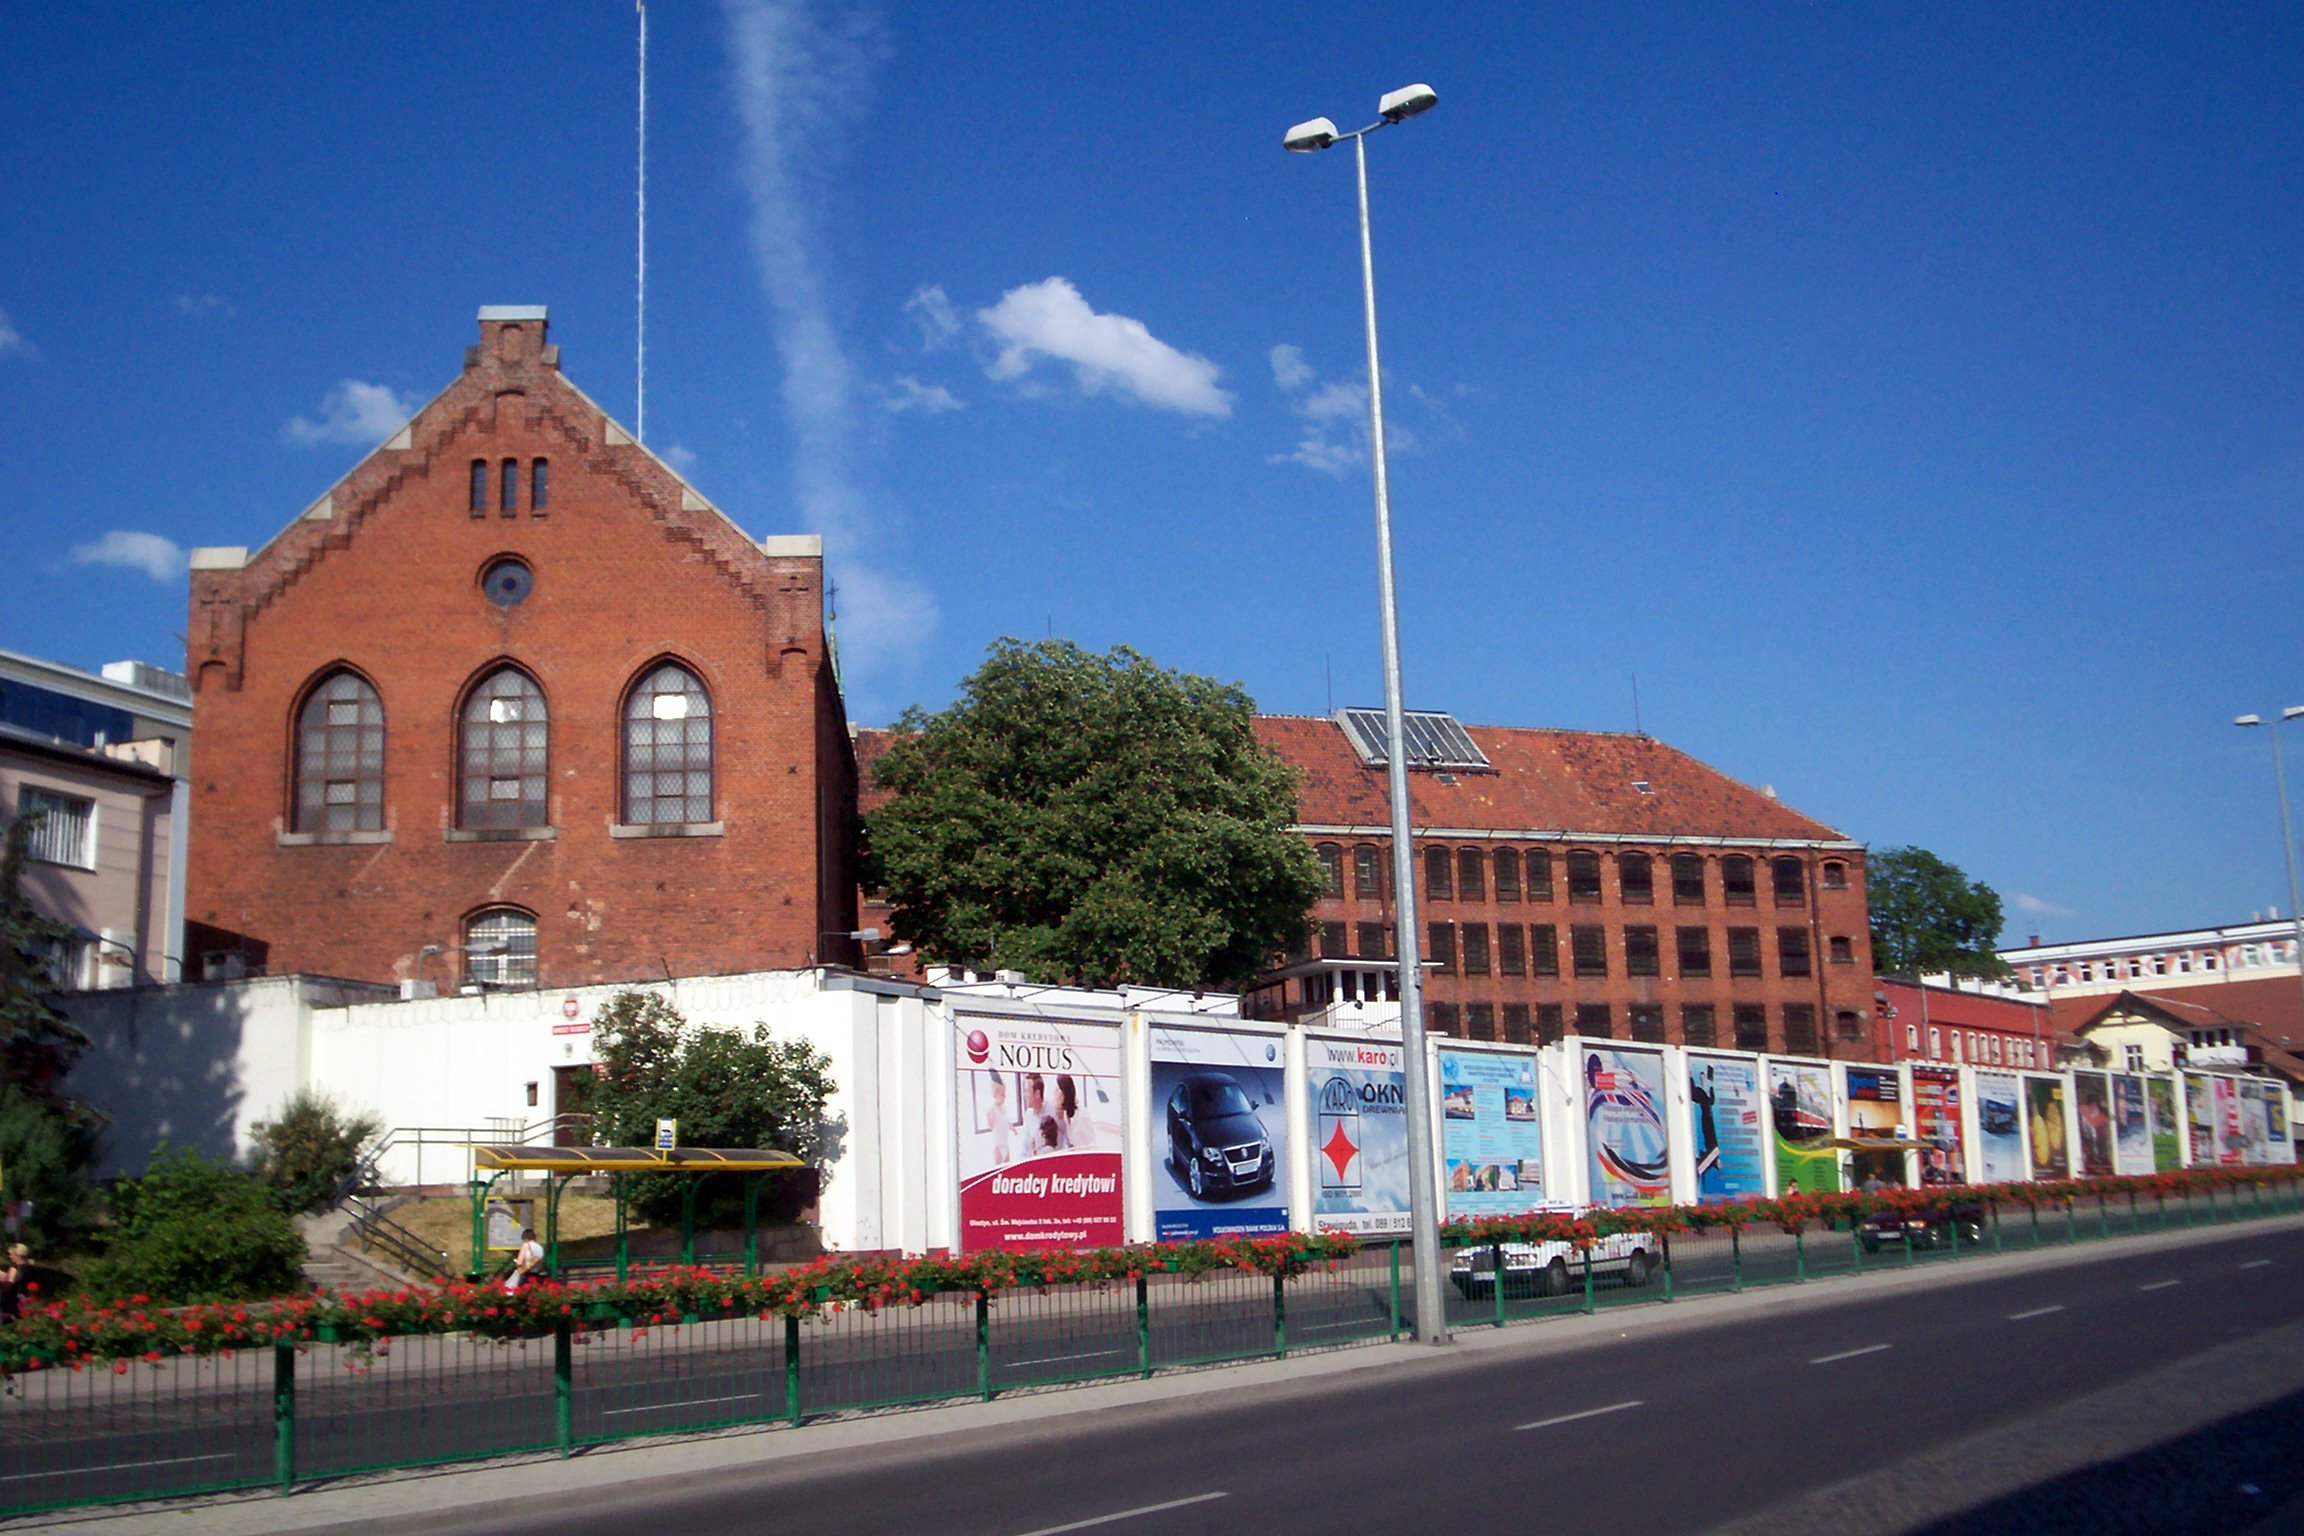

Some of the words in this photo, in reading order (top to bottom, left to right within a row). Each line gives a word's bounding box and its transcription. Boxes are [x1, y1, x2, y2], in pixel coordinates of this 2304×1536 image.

[1000, 1044, 1073, 1070] NOTUS
[1328, 1046, 1399, 1068] www.karo.pl
[1362, 1083, 1405, 1104] OKN
[1362, 1104, 1406, 1115] DREWNIA
[992, 1173, 1048, 1198] doradcy
[1051, 1173, 1116, 1198] kredytowi
